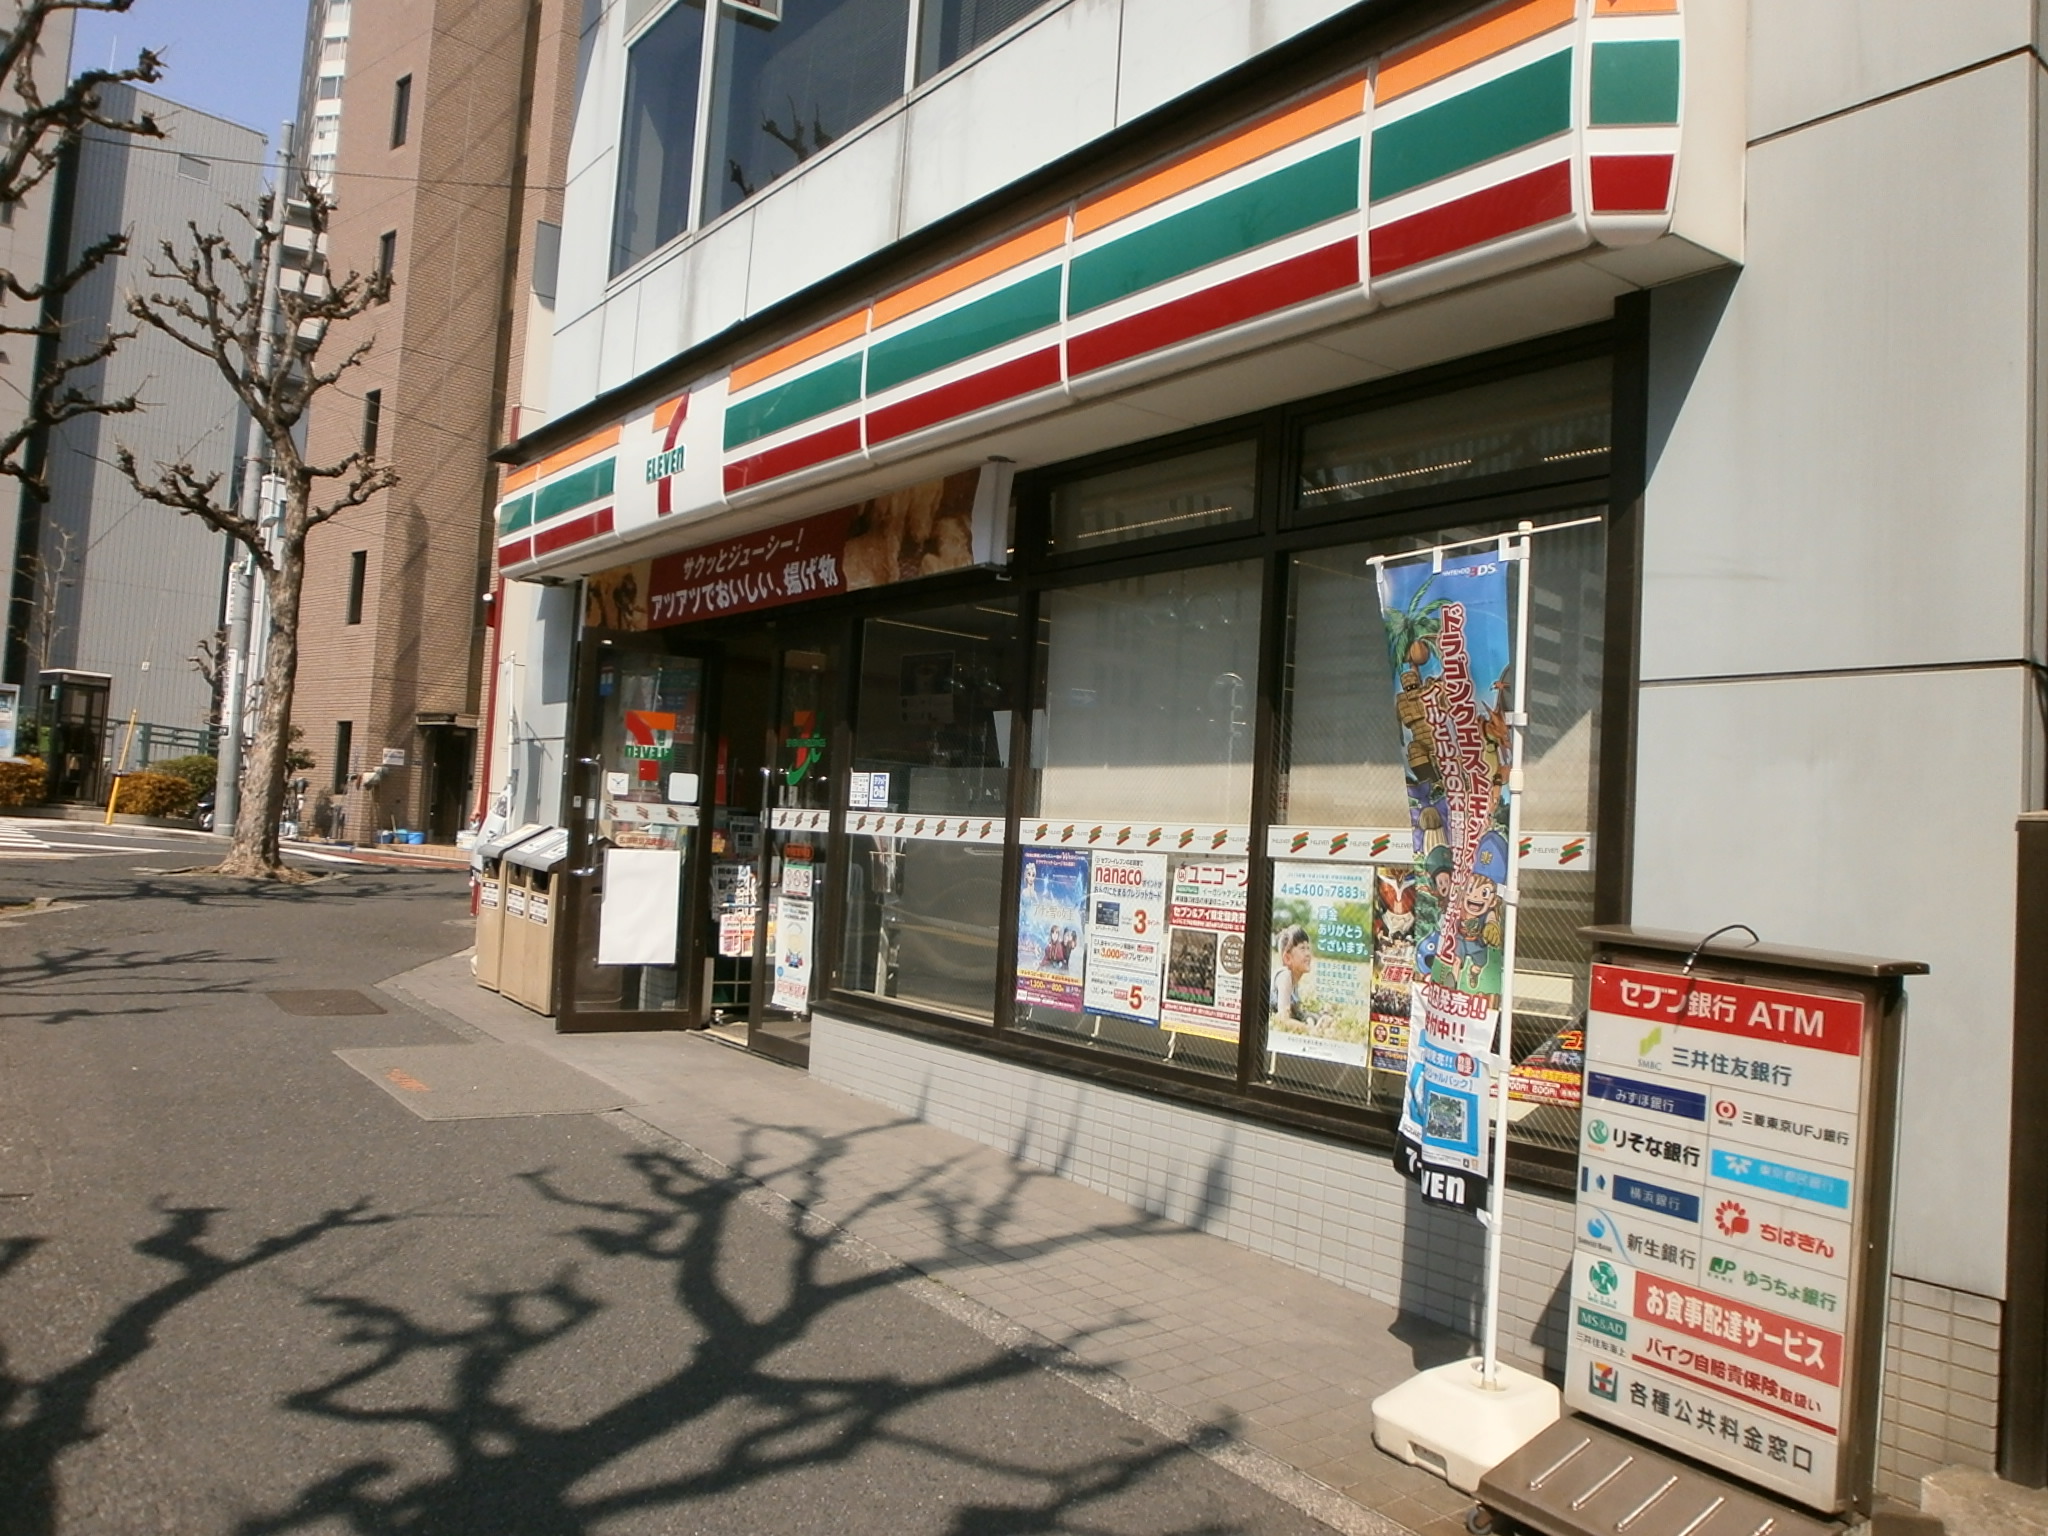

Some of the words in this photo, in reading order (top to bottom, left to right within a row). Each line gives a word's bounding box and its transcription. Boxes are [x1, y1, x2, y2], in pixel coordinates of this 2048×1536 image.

[652, 391, 690, 517] 7
[652, 553, 839, 620] アツアツでおいしい、揚げ物
[1469, 562, 1497, 578] 3DS
[1095, 866, 1142, 886] nanaco
[1318, 923, 1363, 939] ありがとう
[1318, 939, 1368, 956] ございます。
[1129, 984, 1142, 1010] 5
[1620, 978, 1737, 1024] セブン銀行
[1748, 1004, 1824, 1039] ATM
[1637, 1059, 1662, 1071] SMBC
[1671, 1046, 1793, 1087] 三井住友銀行
[1615, 1088, 1675, 1113] みずほ銀行
[1741, 1110, 1850, 1146] 三菱東京UFJ銀行
[1613, 1127, 1700, 1168] りそな銀行
[1630, 1186, 1681, 1211] 横浜銀行
[1627, 1233, 1696, 1270] 新生銀行
[1743, 1270, 1837, 1312] ゆうちょ銀行
[1580, 1311, 1624, 1336] MS&AD
[1646, 1286, 1825, 1370] お食事配達サービス
[1646, 1337, 1821, 1412] バイク自賠責保険取扱い
[1630, 1381, 1813, 1474] 各種公共料金窓口
